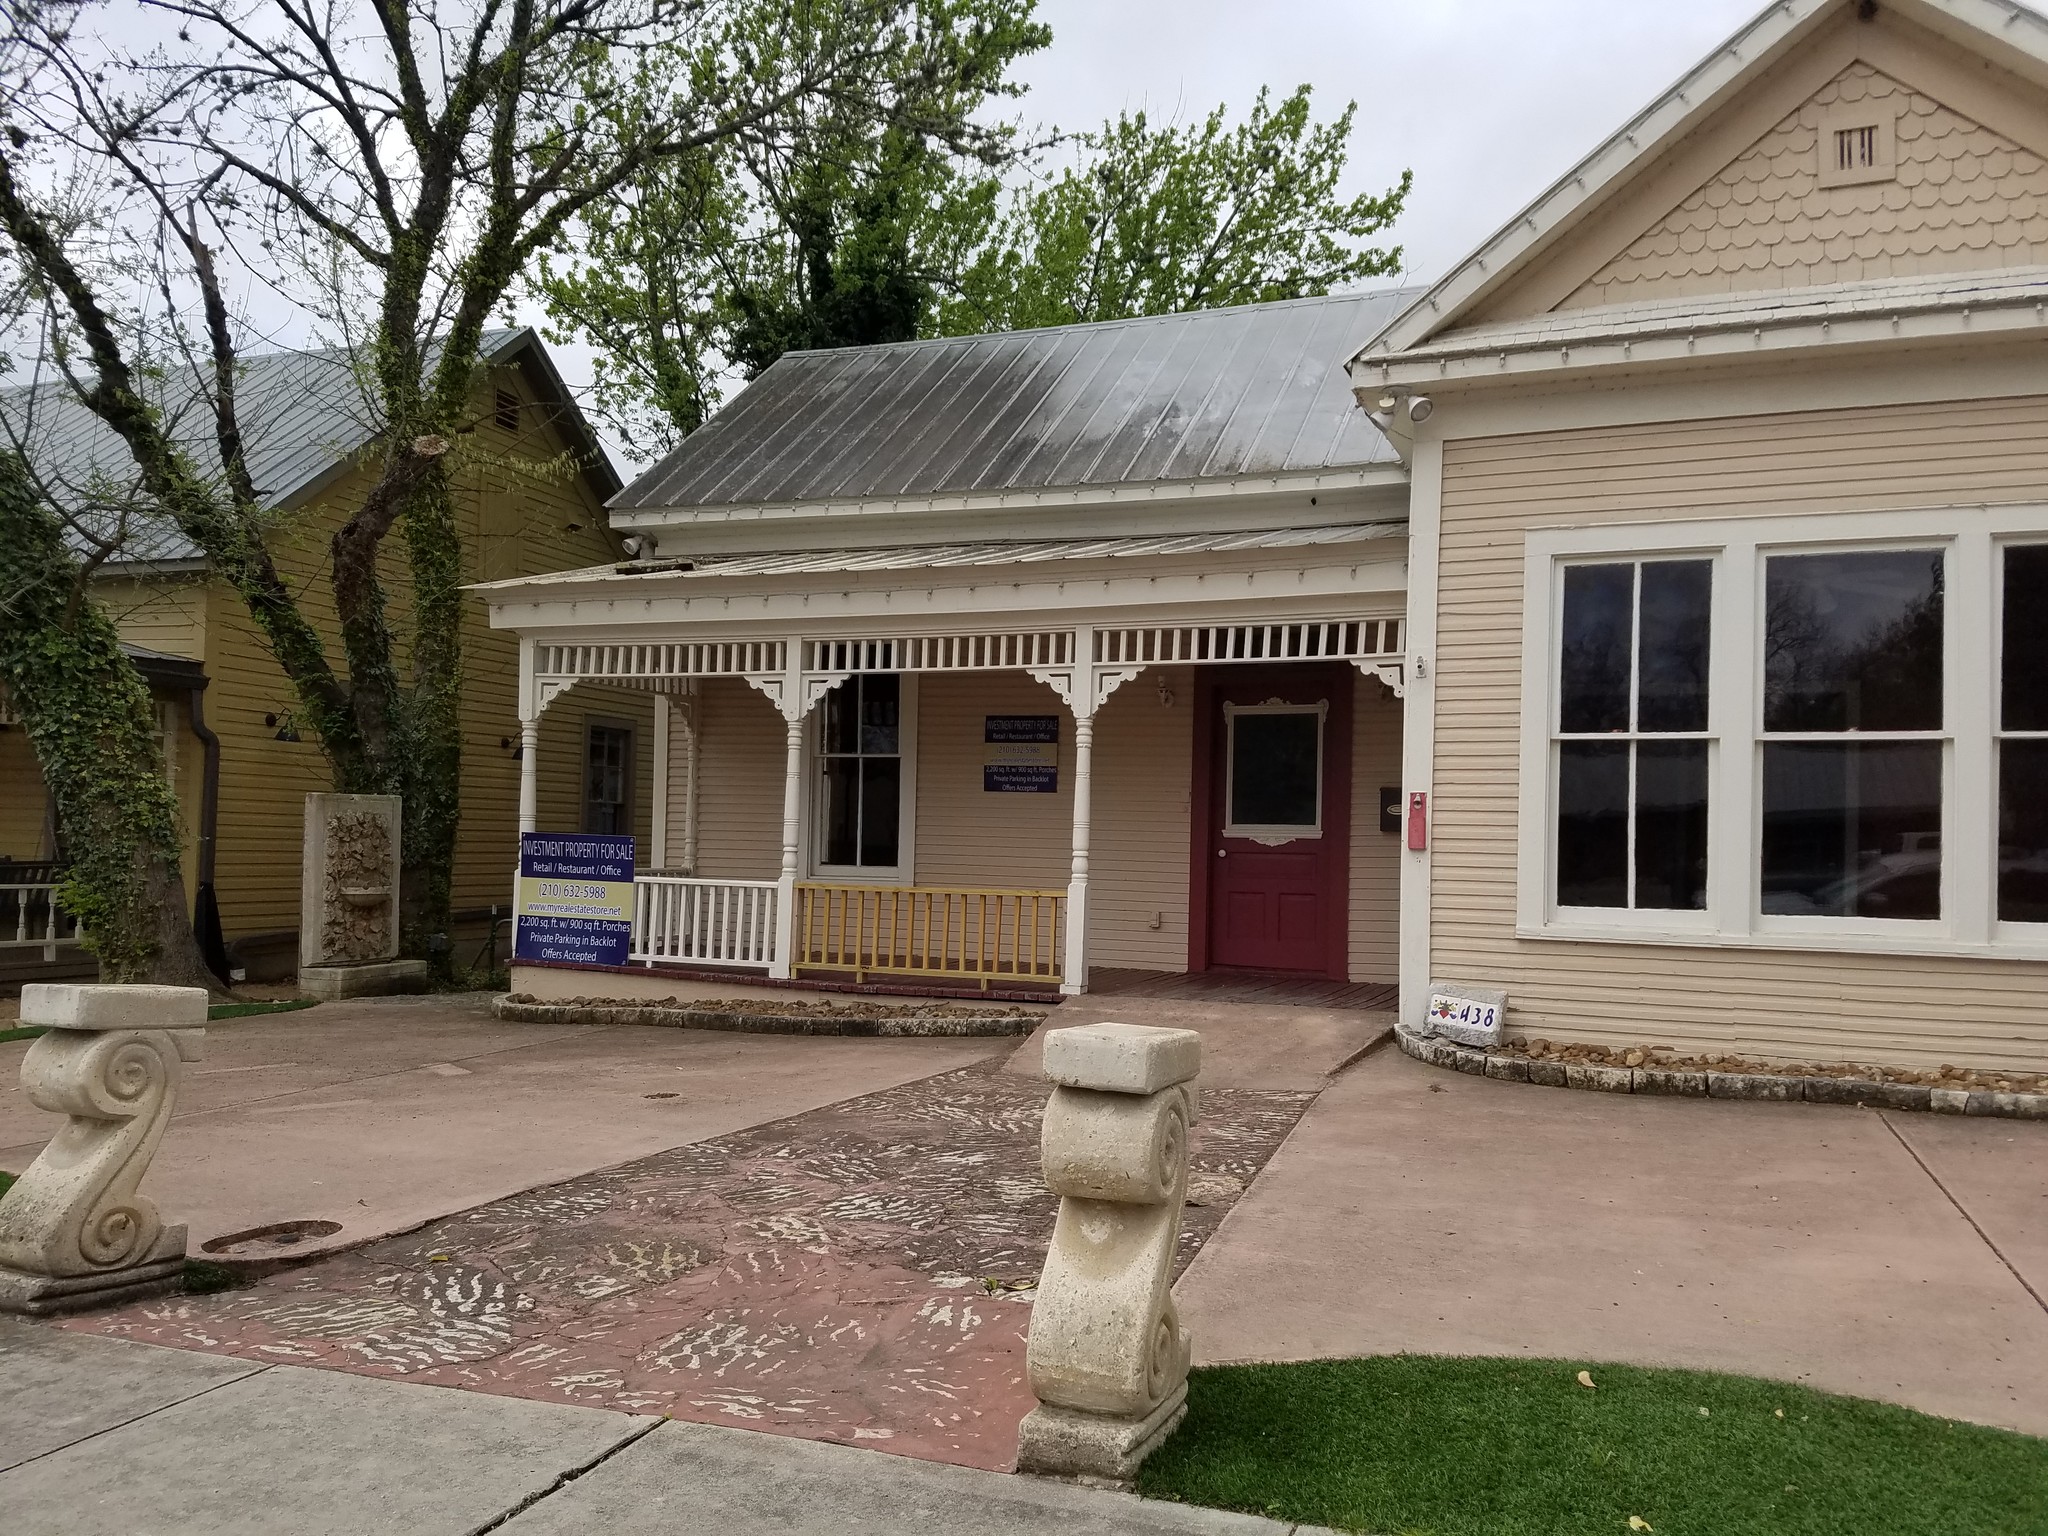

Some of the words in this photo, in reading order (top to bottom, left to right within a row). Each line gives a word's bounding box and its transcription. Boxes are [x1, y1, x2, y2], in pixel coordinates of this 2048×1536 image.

[523, 840, 564, 857] INVESTMENT
[566, 842, 599, 858] PROPERTY
[601, 844, 615, 859] FOR
[616, 844, 633, 860] SALE
[534, 862, 553, 872] Retail
[559, 863, 594, 874] Restaurant
[601, 865, 621, 876] Office
[539, 882, 561, 897] (210)
[564, 884, 605, 899] 632-5988
[528, 903, 621, 916] www.myrealestatestore.net
[521, 916, 539, 927] 2,200
[540, 918, 550, 929] sq.
[560, 919, 569, 929] w/
[570, 919, 583, 929] 900
[603, 921, 630, 932] Porches
[530, 932, 553, 943] Private
[555, 934, 580, 947] Parking
[582, 935, 589, 944] in
[591, 936, 616, 947] Backlot
[542, 948, 563, 959] Offers
[565, 950, 596, 962] Accepted
[1461, 1004, 1494, 1027] 438
